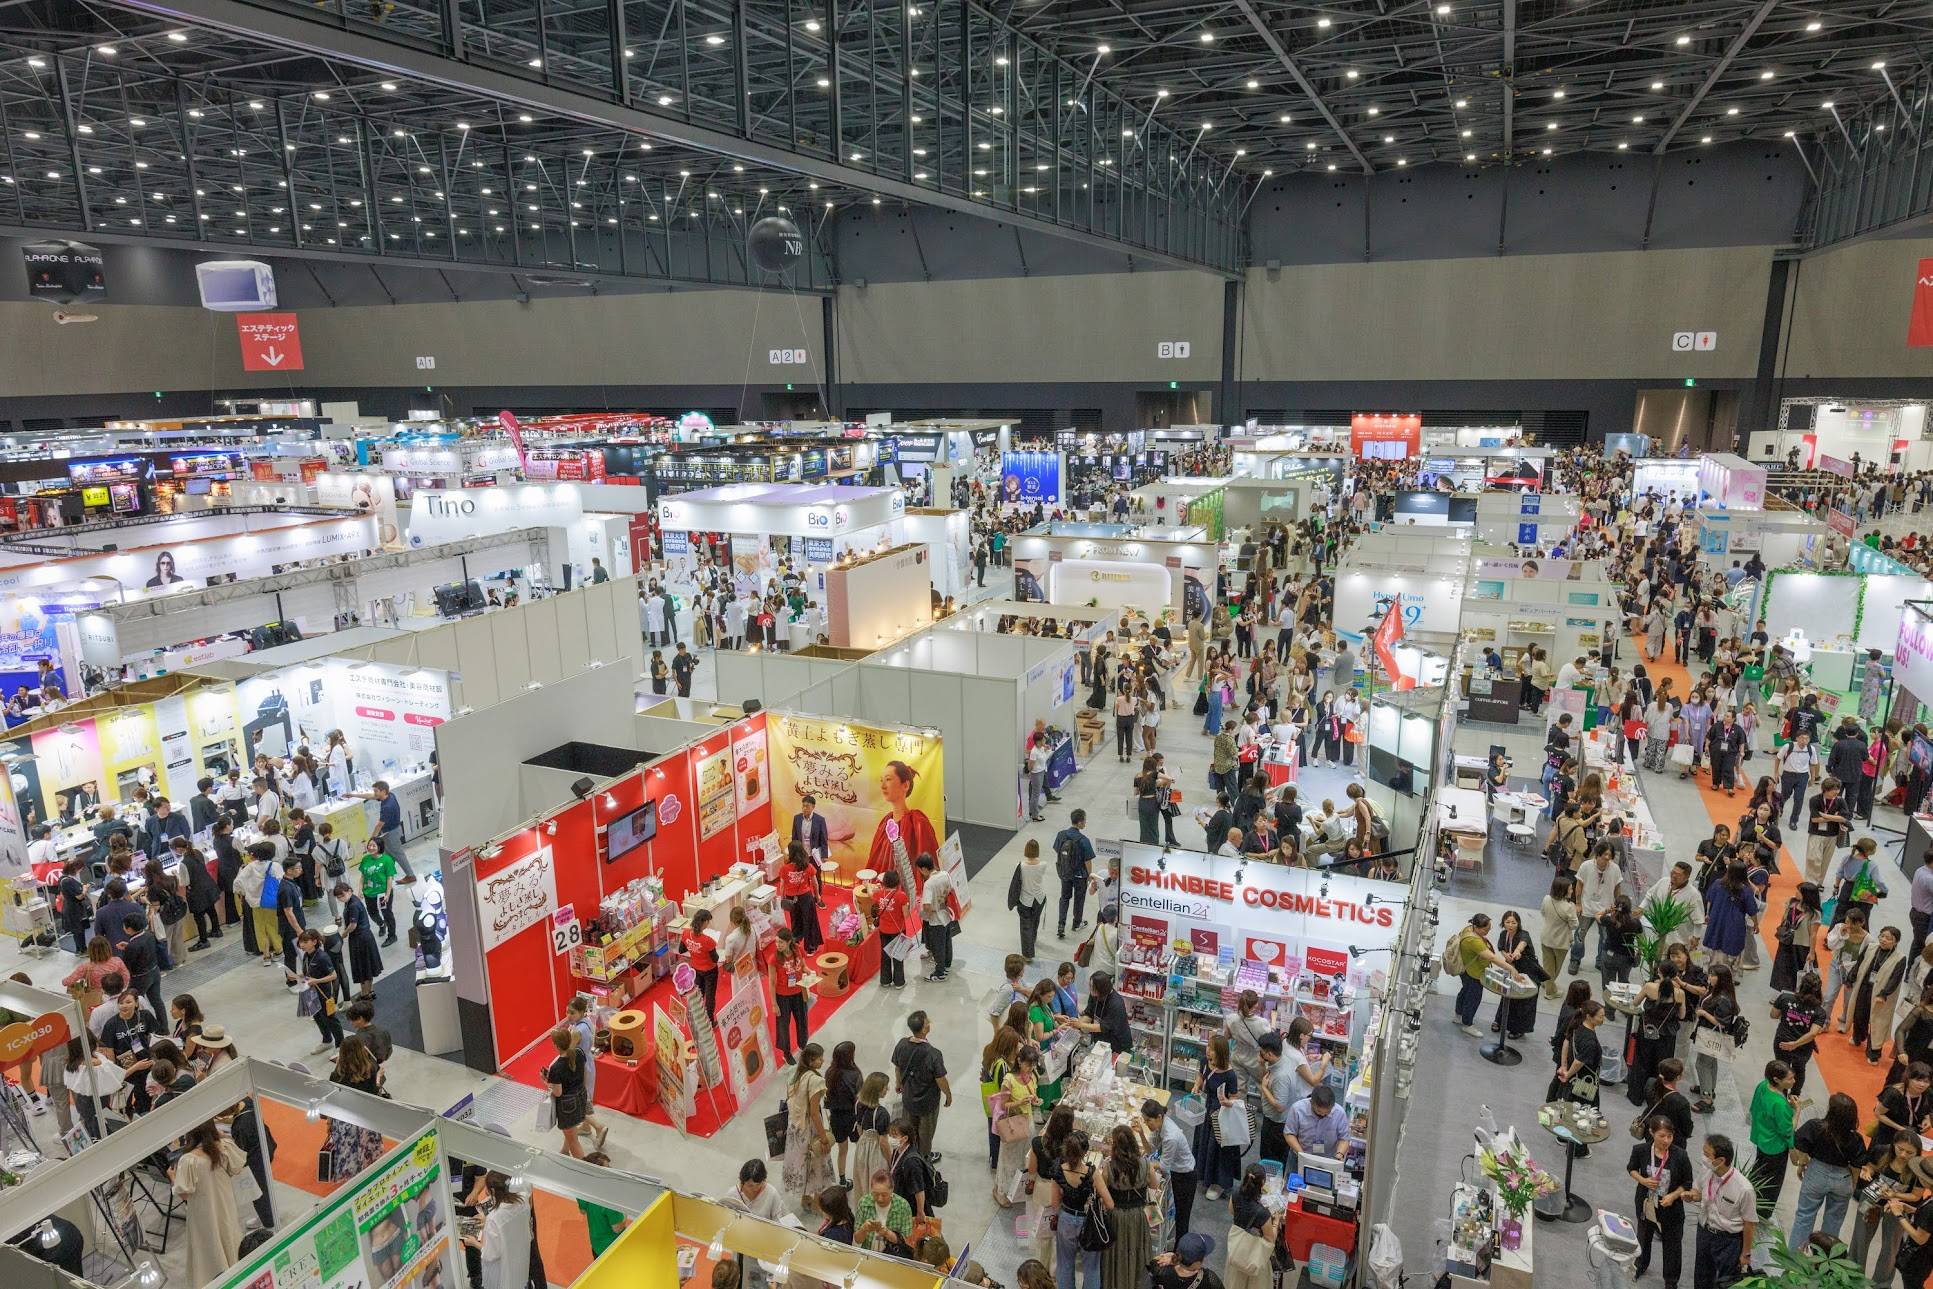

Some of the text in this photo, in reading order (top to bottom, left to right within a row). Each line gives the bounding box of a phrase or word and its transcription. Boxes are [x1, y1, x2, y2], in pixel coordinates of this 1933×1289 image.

[241, 324, 295, 332] エステティック
[254, 333, 286, 341] ステージ
[1161, 344, 1170, 356] B
[1677, 338, 1690, 351] C
[424, 495, 475, 514] Tino
[808, 512, 828, 525] Bio
[1896, 642, 1910, 669] US!
[1130, 865, 1394, 928] SHINBEE COSMETICS
[555, 923, 580, 953] 28
